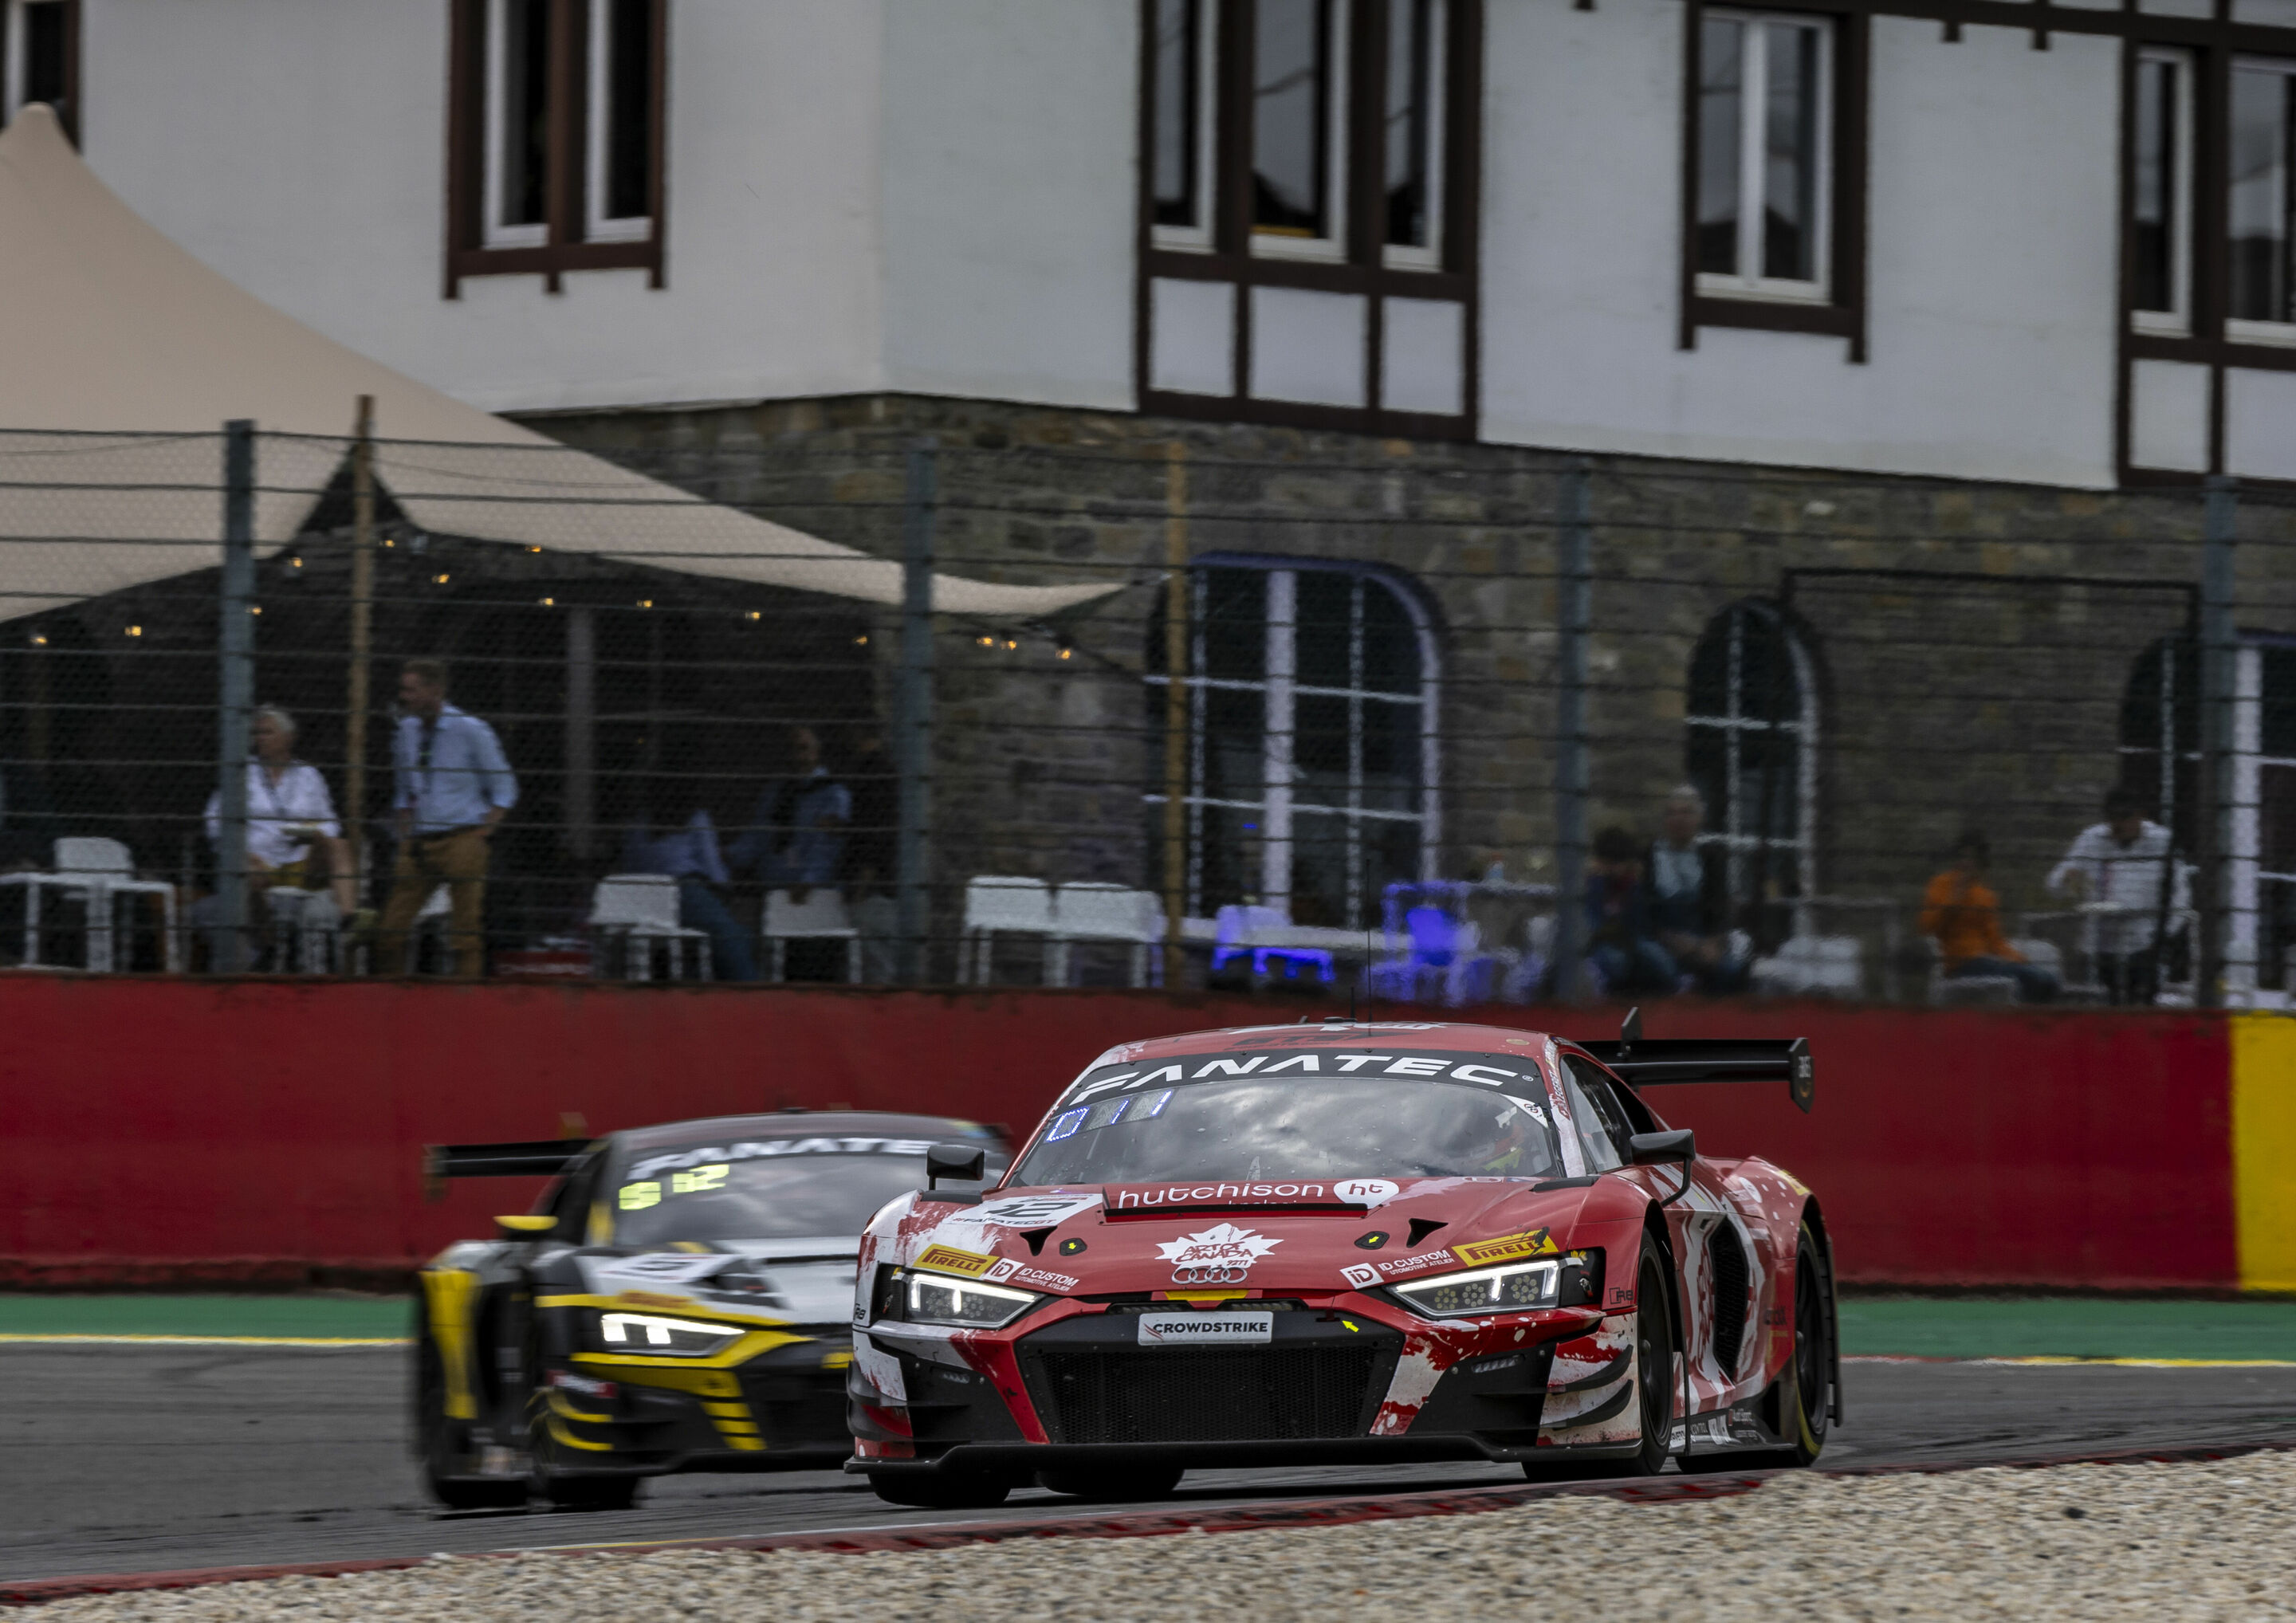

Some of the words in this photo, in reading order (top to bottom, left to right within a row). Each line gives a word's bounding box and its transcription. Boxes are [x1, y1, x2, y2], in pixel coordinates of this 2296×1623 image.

[1069, 1054, 1519, 1106] FANATEC
[627, 1137, 942, 1181] FANATE
[1119, 1183, 1323, 1208] hutchison
[1349, 1183, 1384, 1196] ht
[922, 1248, 989, 1271] PIRELLI
[1175, 1248, 1254, 1263] CANADA
[1378, 1262, 1394, 1271] ID
[1394, 1249, 1451, 1267] CUSTOM
[1018, 1267, 1033, 1276] ID
[1031, 1270, 1080, 1287] CUSTOM
[1153, 1322, 1268, 1334] CROWDSTRIKE
